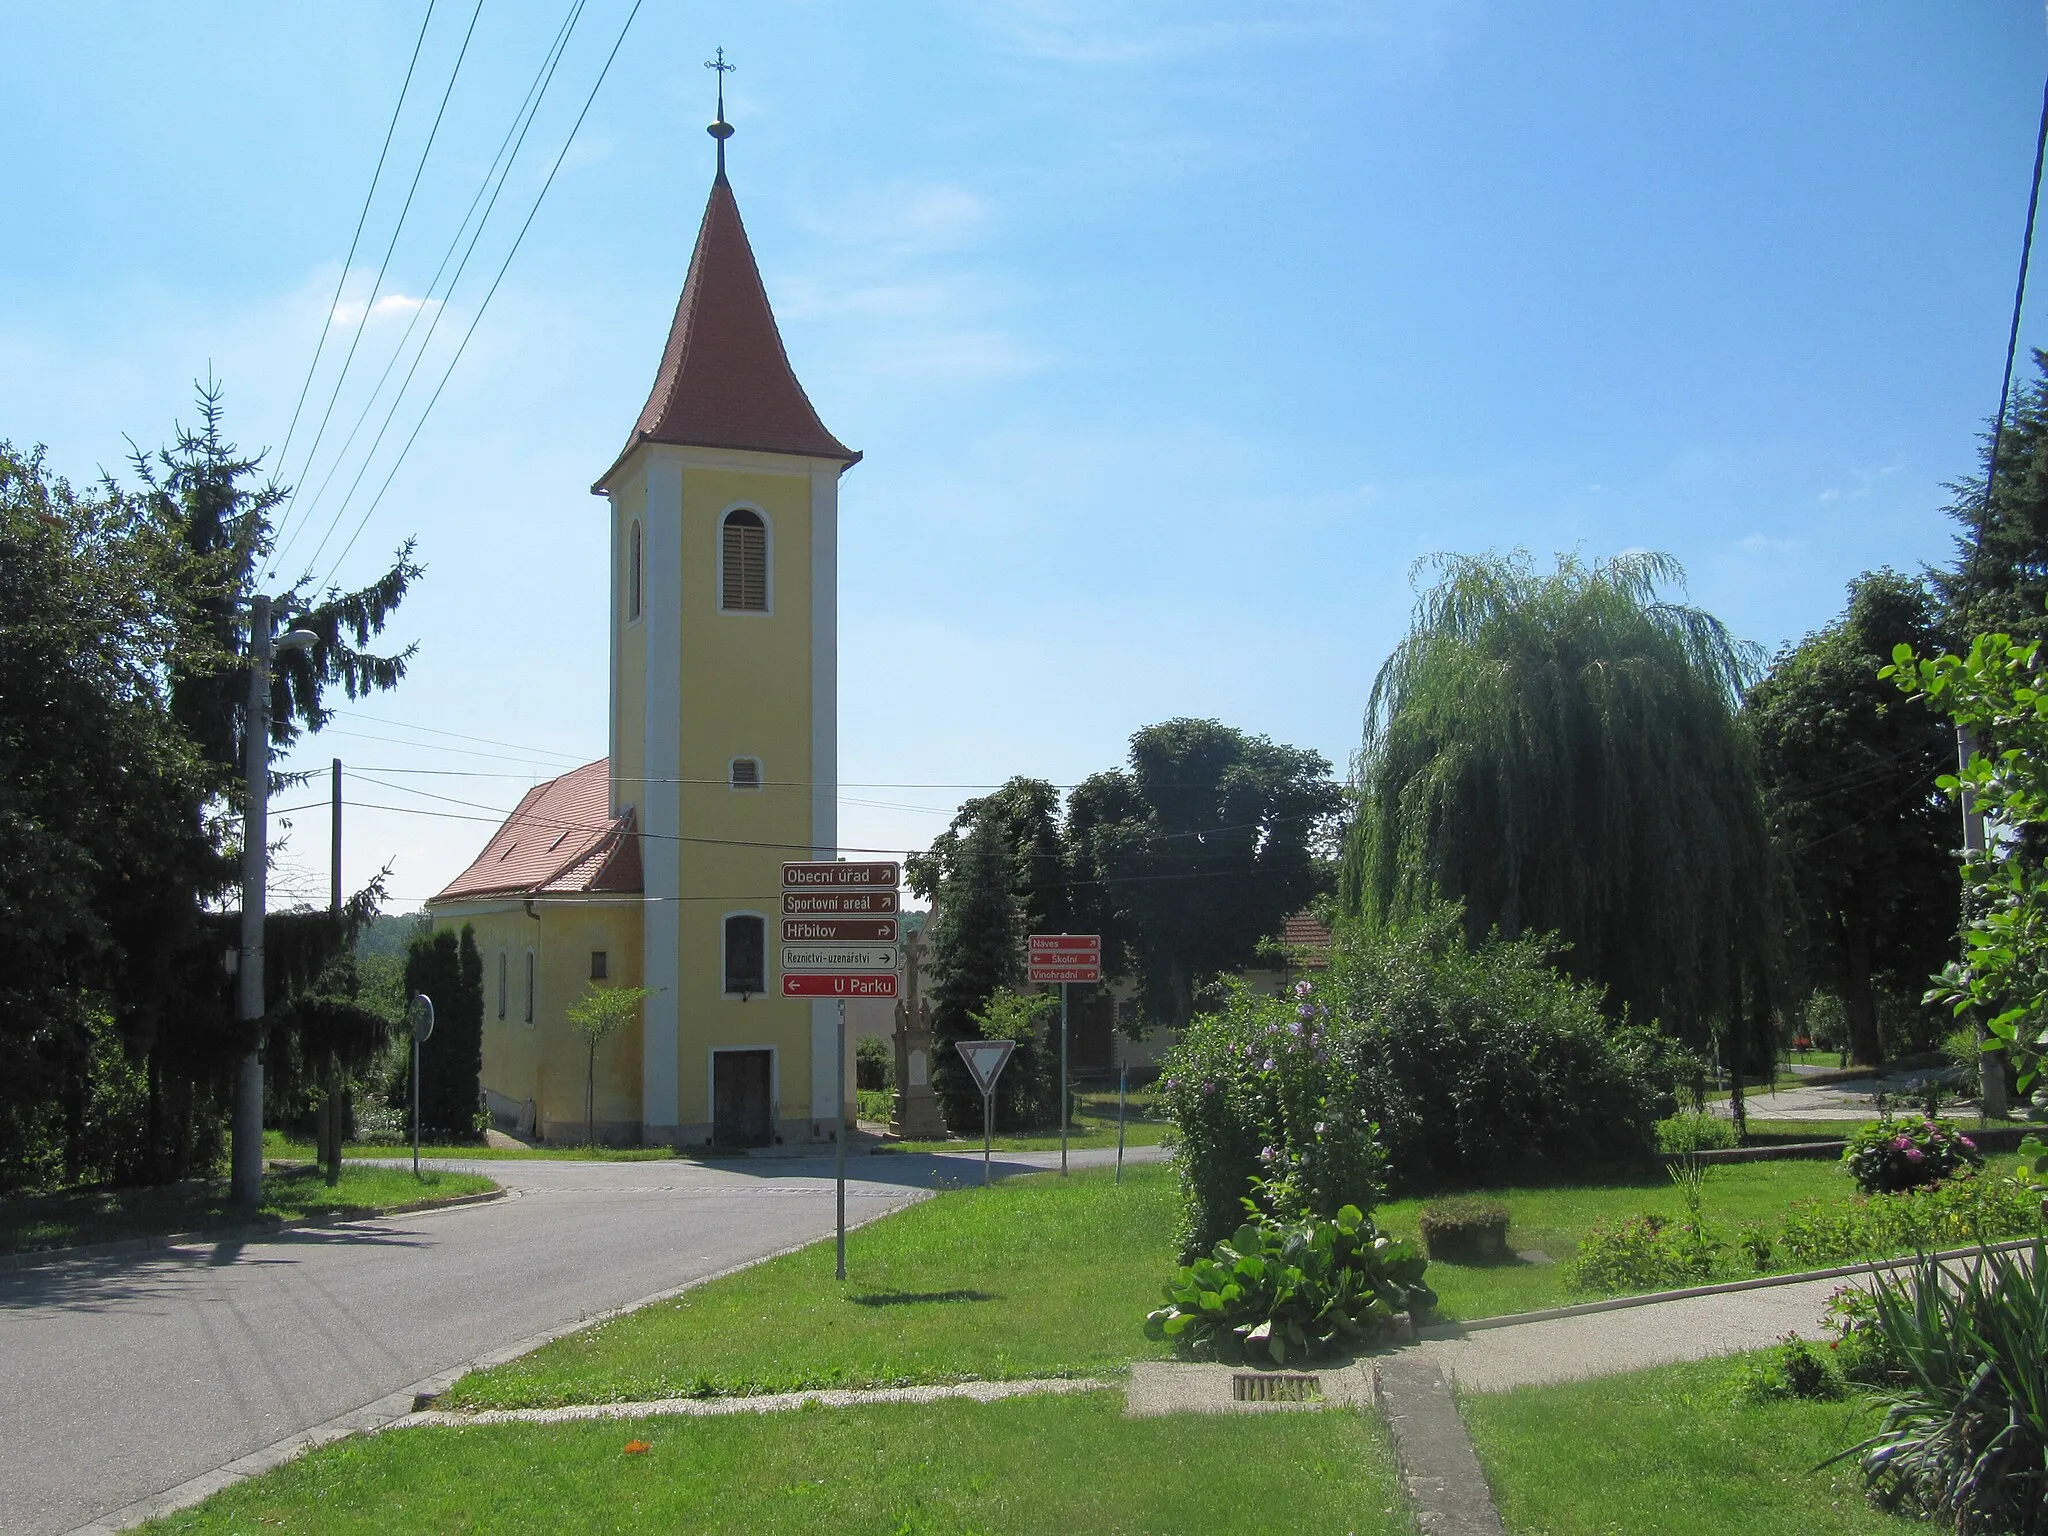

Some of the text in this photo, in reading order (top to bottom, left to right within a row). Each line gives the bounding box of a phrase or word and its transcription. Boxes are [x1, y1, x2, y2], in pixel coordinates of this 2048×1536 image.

[788, 868, 870, 883] Obecní úřad
[787, 895, 871, 913] Sportovní areál
[787, 923, 836, 937] Hřbitov
[1033, 939, 1059, 948] Náves
[1051, 954, 1078, 963] Školní
[1032, 970, 1078, 979] Vinohradní
[834, 979, 892, 993] U Parku
